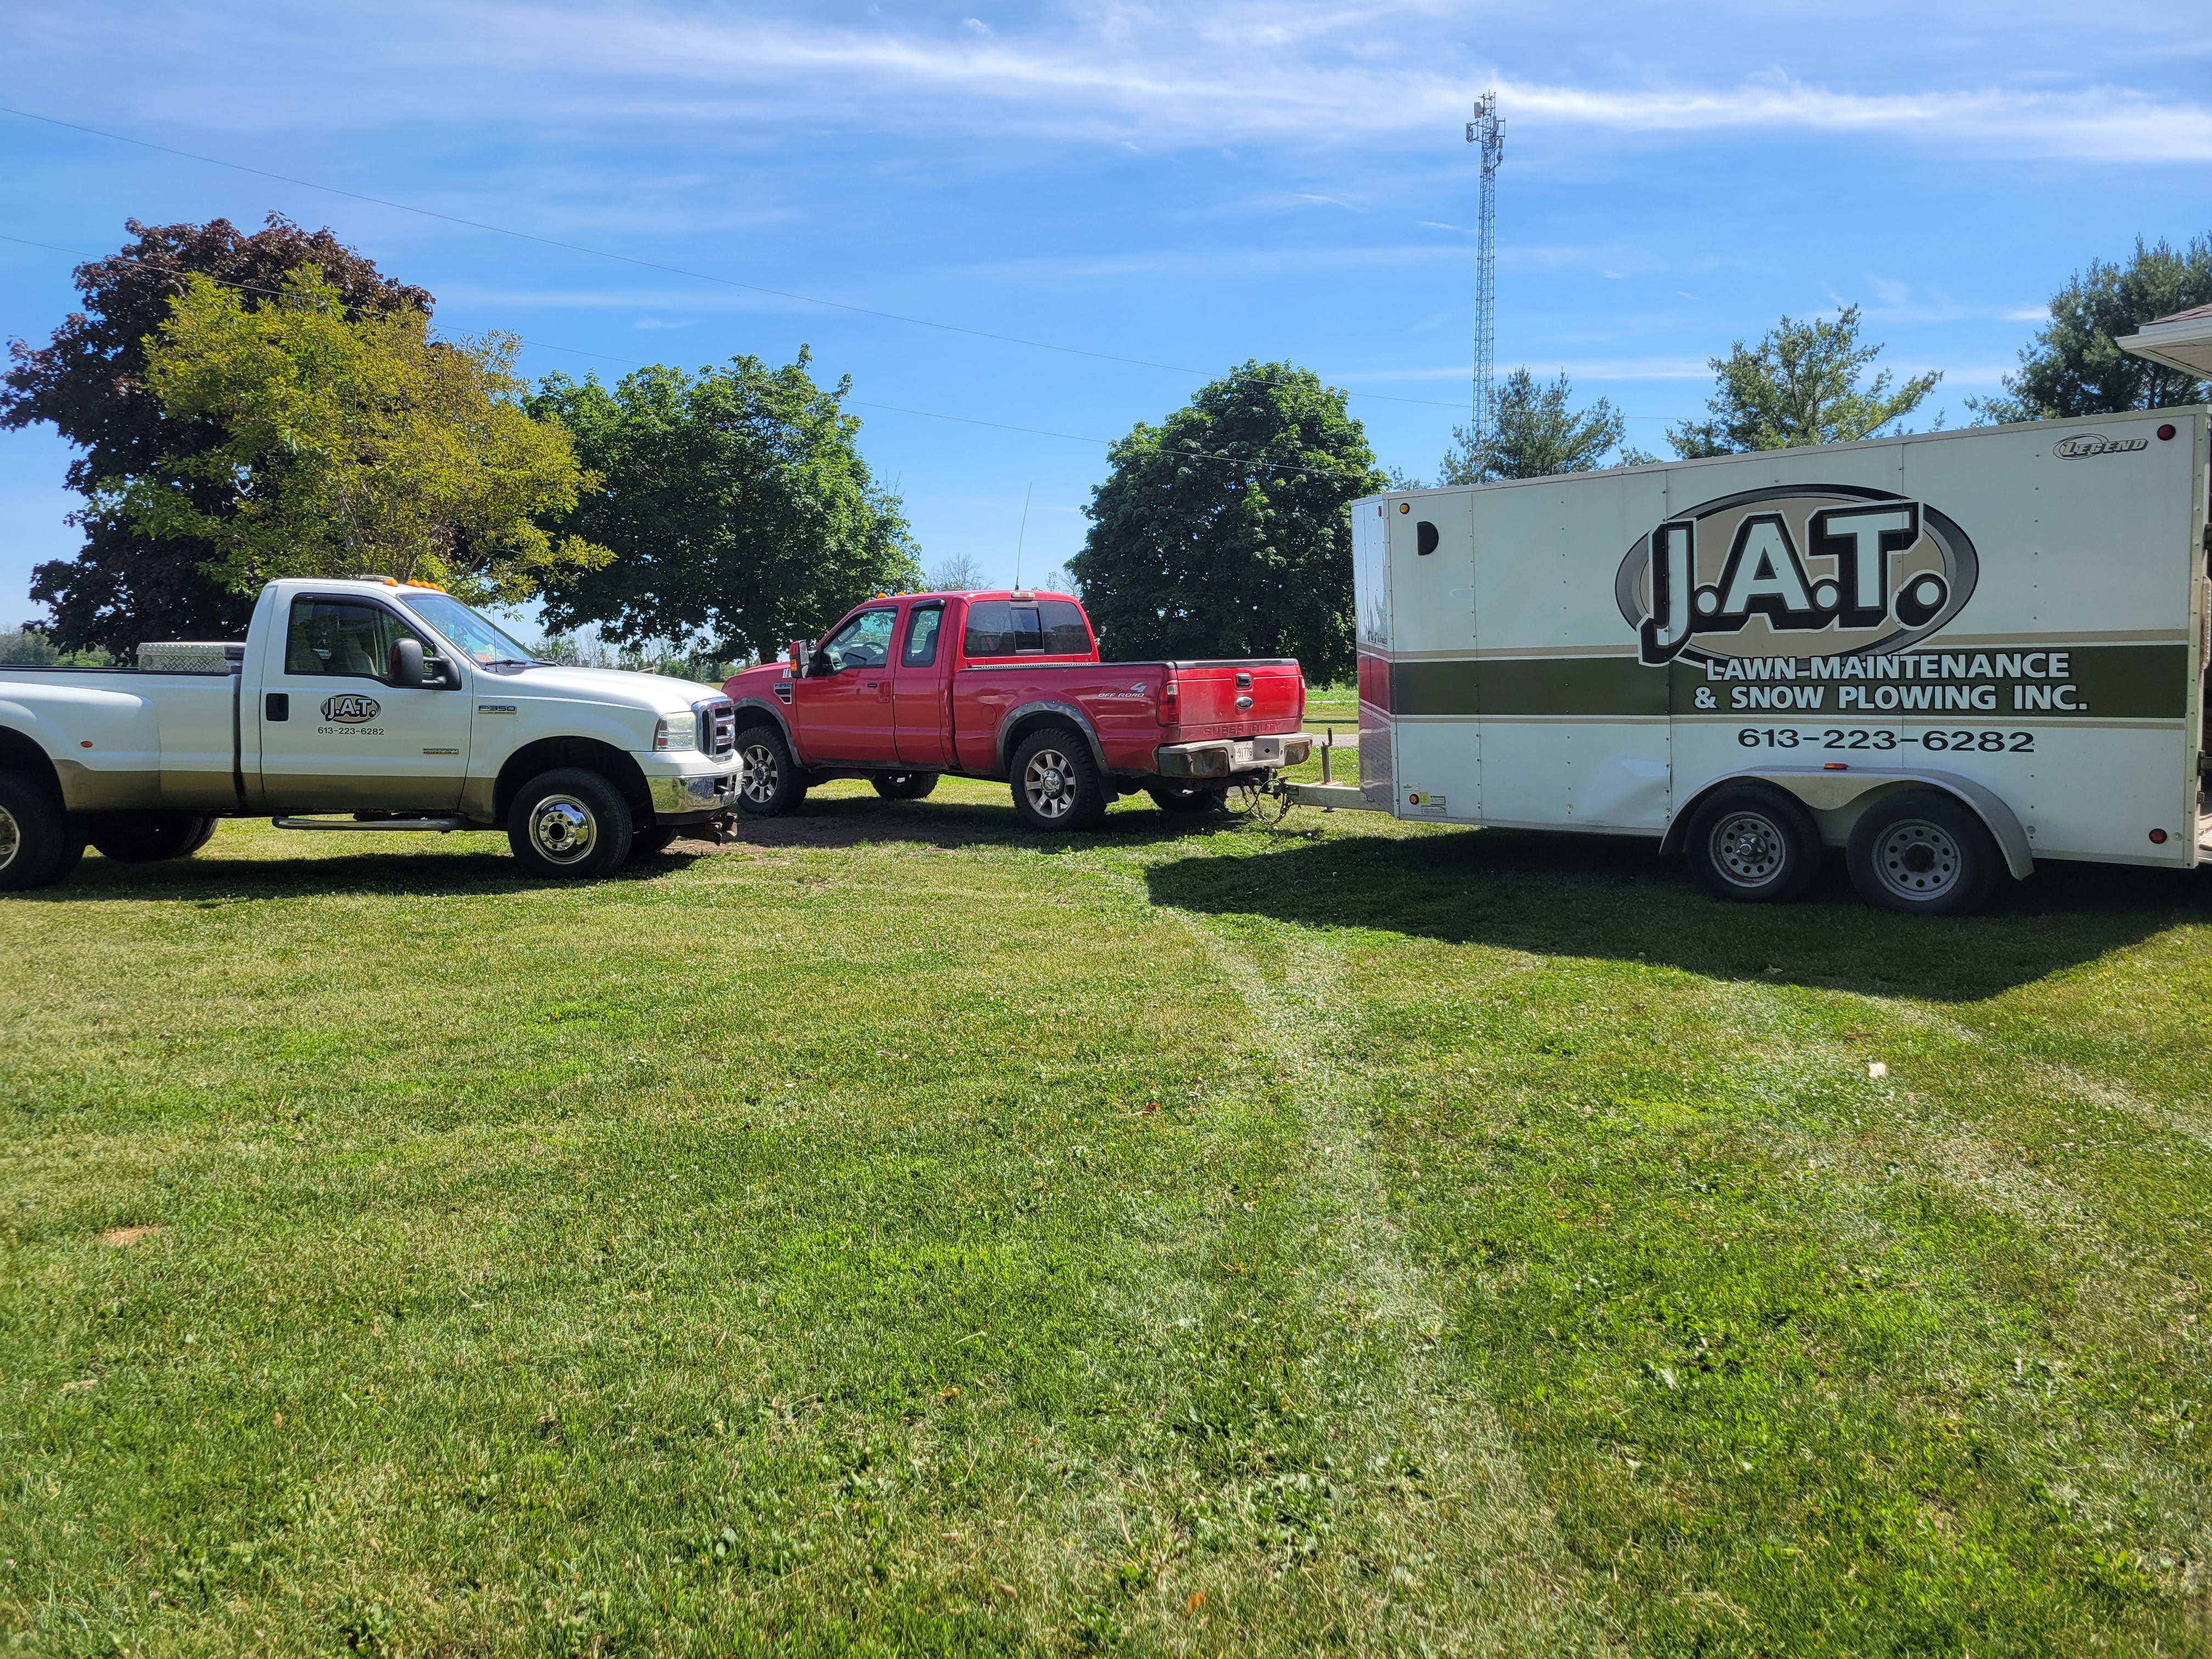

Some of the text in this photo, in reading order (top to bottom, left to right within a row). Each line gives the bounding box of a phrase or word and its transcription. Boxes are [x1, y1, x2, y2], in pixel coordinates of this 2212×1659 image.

[2062, 438, 2149, 457] LEGEND
[1640, 501, 1948, 663] J.A.T.
[1706, 653, 2069, 681] LAWN MAINTENANCE
[325, 697, 377, 721] J.A.T.
[1694, 685, 2088, 710] & SNOW PLOWING INC.
[317, 726, 385, 736] 613-223-6282
[1203, 721, 1280, 736] SUPER DUTY
[1737, 728, 2035, 753] 613-223-6282
